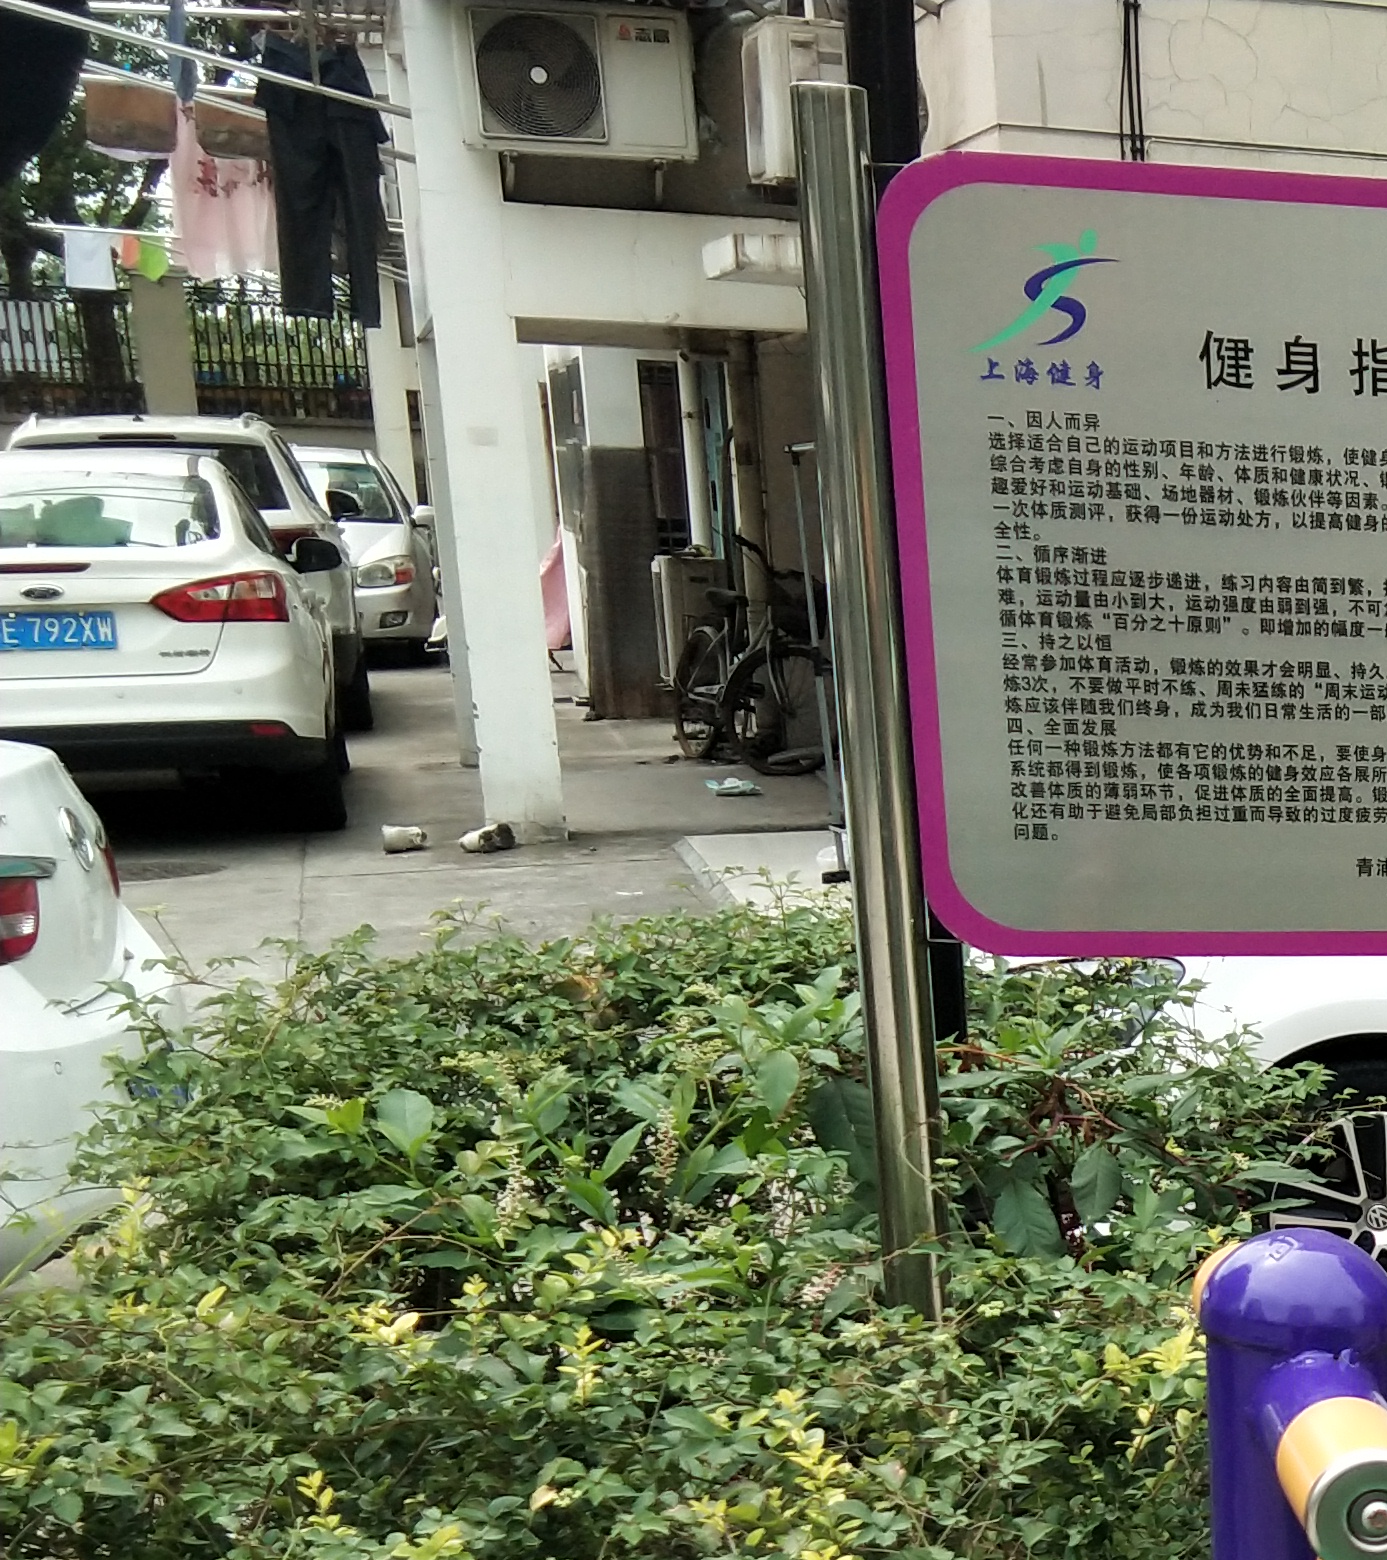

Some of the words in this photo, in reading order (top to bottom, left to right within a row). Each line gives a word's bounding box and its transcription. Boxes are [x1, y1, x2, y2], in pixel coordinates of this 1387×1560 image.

[979, 356, 1104, 389] 上海健身
[988, 410, 1100, 432] 一、因人而异
[994, 521, 1042, 541] 全性。
[996, 545, 1108, 566] 二、循序渐进
[1001, 632, 1113, 651] 三、持之以恒
[1006, 717, 1118, 737] 四、全面发展
[1013, 823, 1060, 841] 问题。
